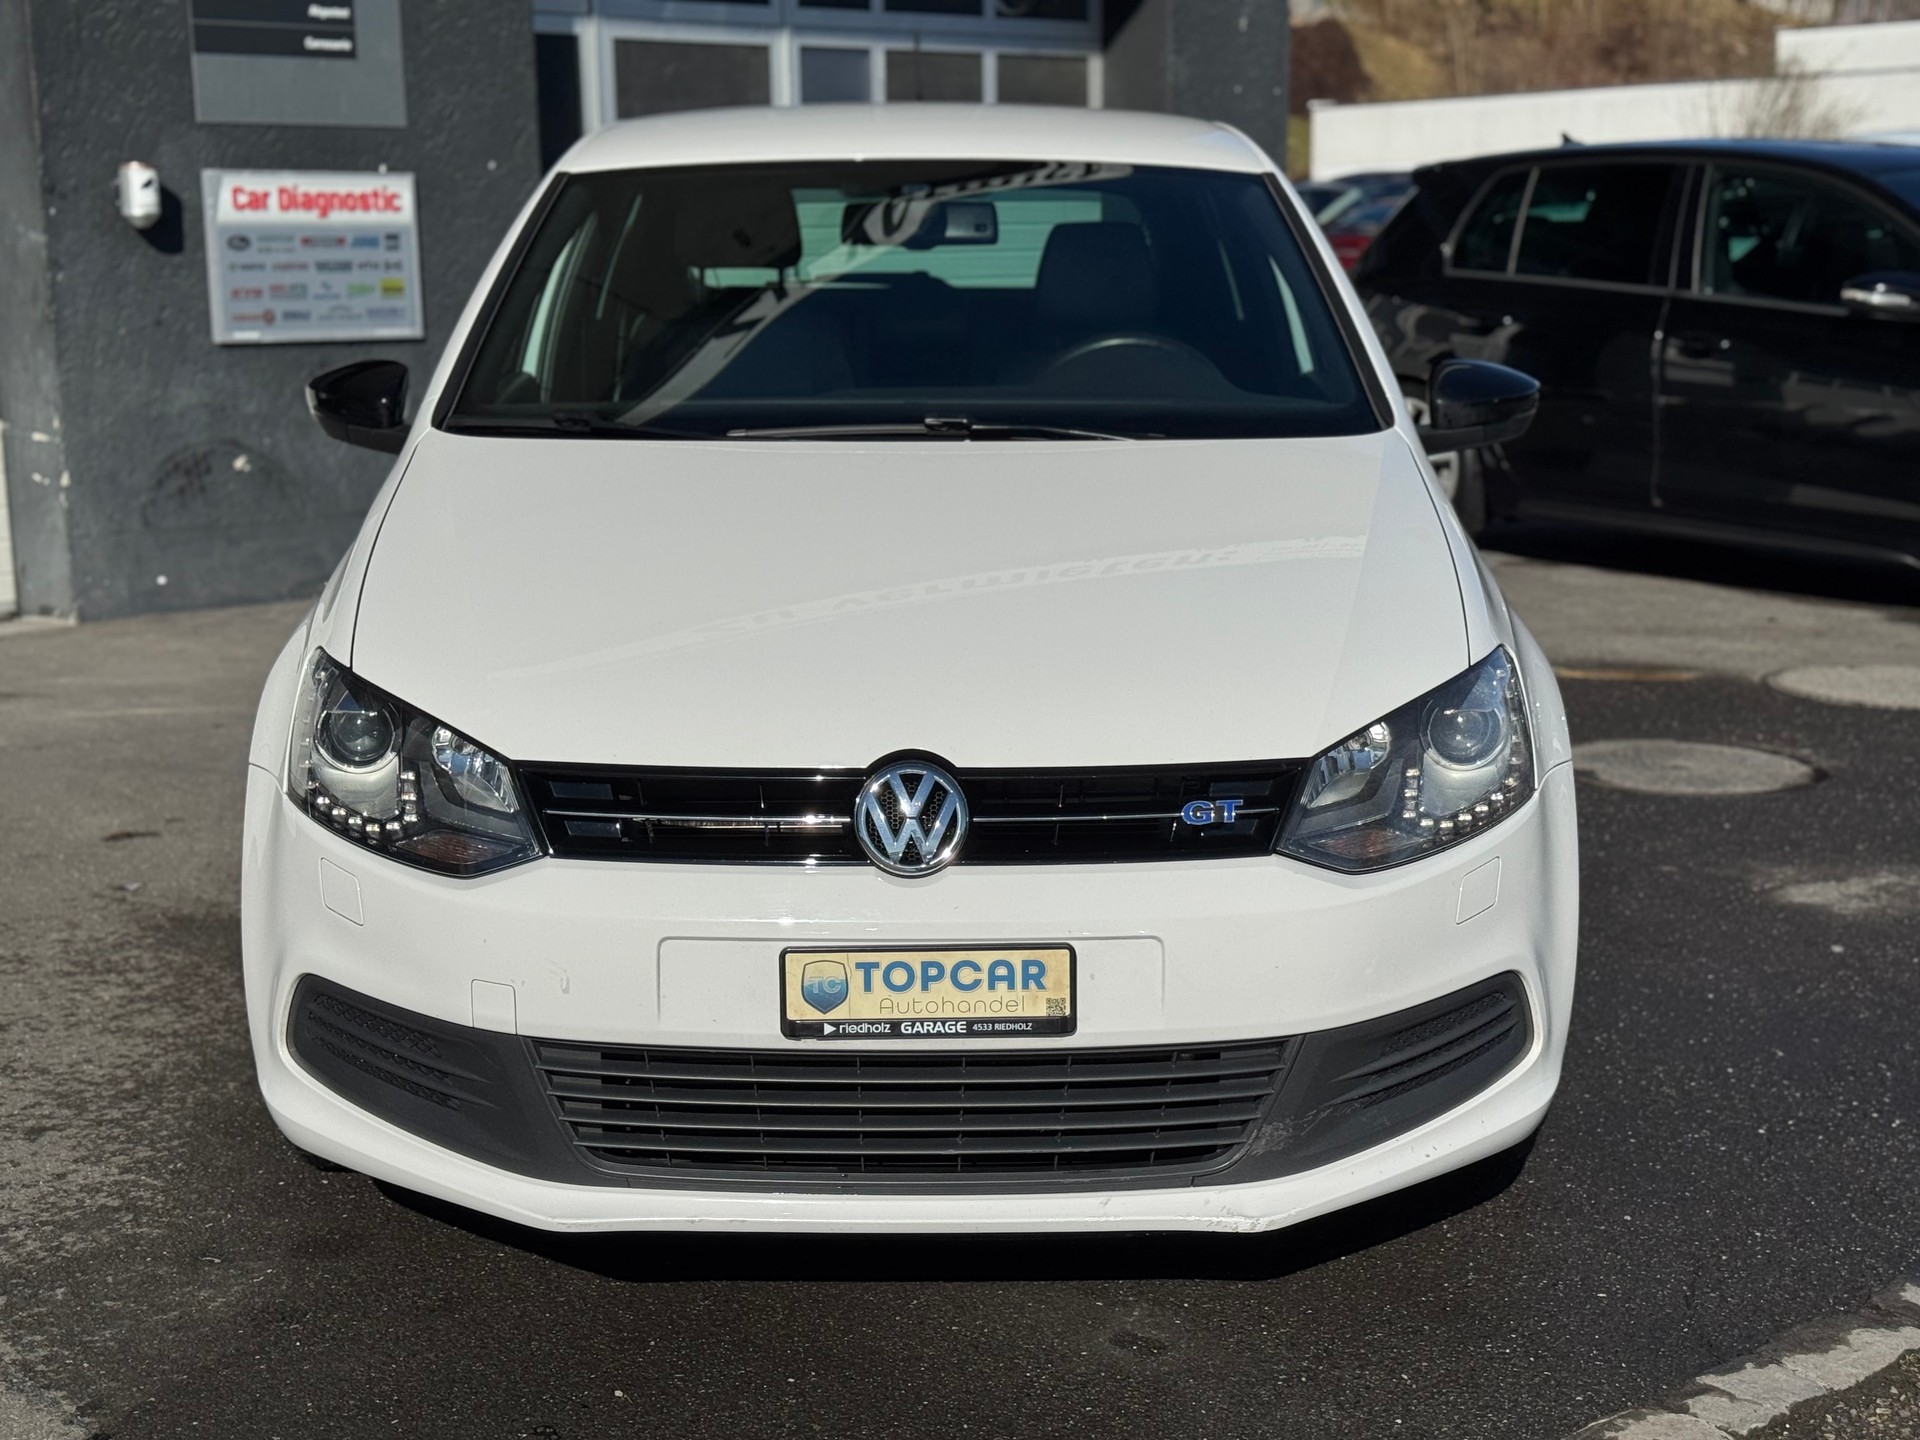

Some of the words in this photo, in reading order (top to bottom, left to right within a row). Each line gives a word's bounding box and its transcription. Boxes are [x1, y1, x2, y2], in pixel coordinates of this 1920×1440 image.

[232, 186, 270, 211] Car
[277, 185, 403, 218] Diagnostic
[862, 766, 961, 867] VW
[1181, 799, 1244, 825] GT
[855, 958, 1048, 994] TOPCAR
[879, 996, 1026, 1015] Autohandel
[839, 1022, 892, 1035] riedholz
[900, 1020, 967, 1035] GARAGE
[972, 1023, 992, 1032] 4533
[994, 1022, 1033, 1032] RIEDHOLZ
